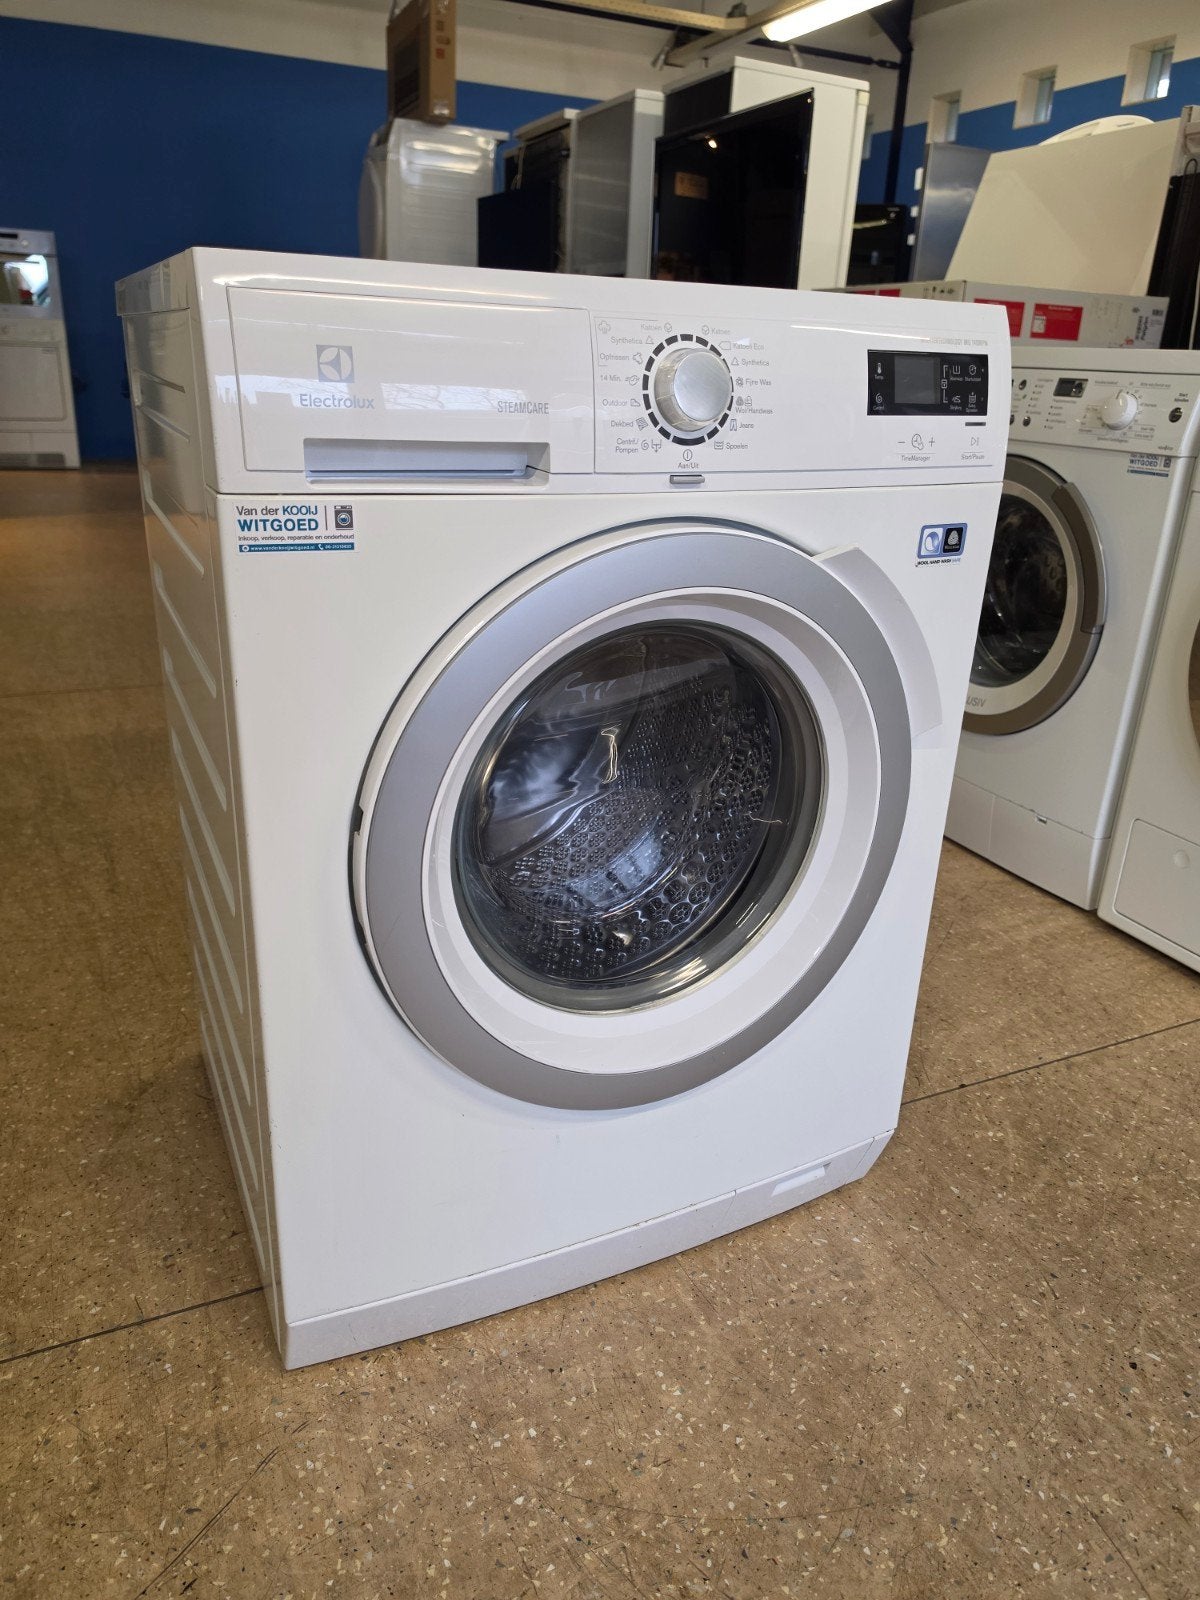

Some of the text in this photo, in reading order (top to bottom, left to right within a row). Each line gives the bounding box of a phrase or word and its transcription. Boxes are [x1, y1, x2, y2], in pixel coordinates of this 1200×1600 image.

[610, 337, 643, 345] Synthetica
[741, 359, 770, 367] Synthetica
[299, 393, 376, 409] Electrolux
[602, 398, 628, 407] Outdoor
[497, 400, 550, 415] STEAMCARE
[610, 420, 634, 428] Dekbed
[615, 446, 638, 455] Pompen
[725, 442, 749, 450] Spoelen
[901, 454, 931, 462] TimeManager
[235, 505, 318, 516] Van der KOOIJ
[237, 518, 319, 532] WITGOED
